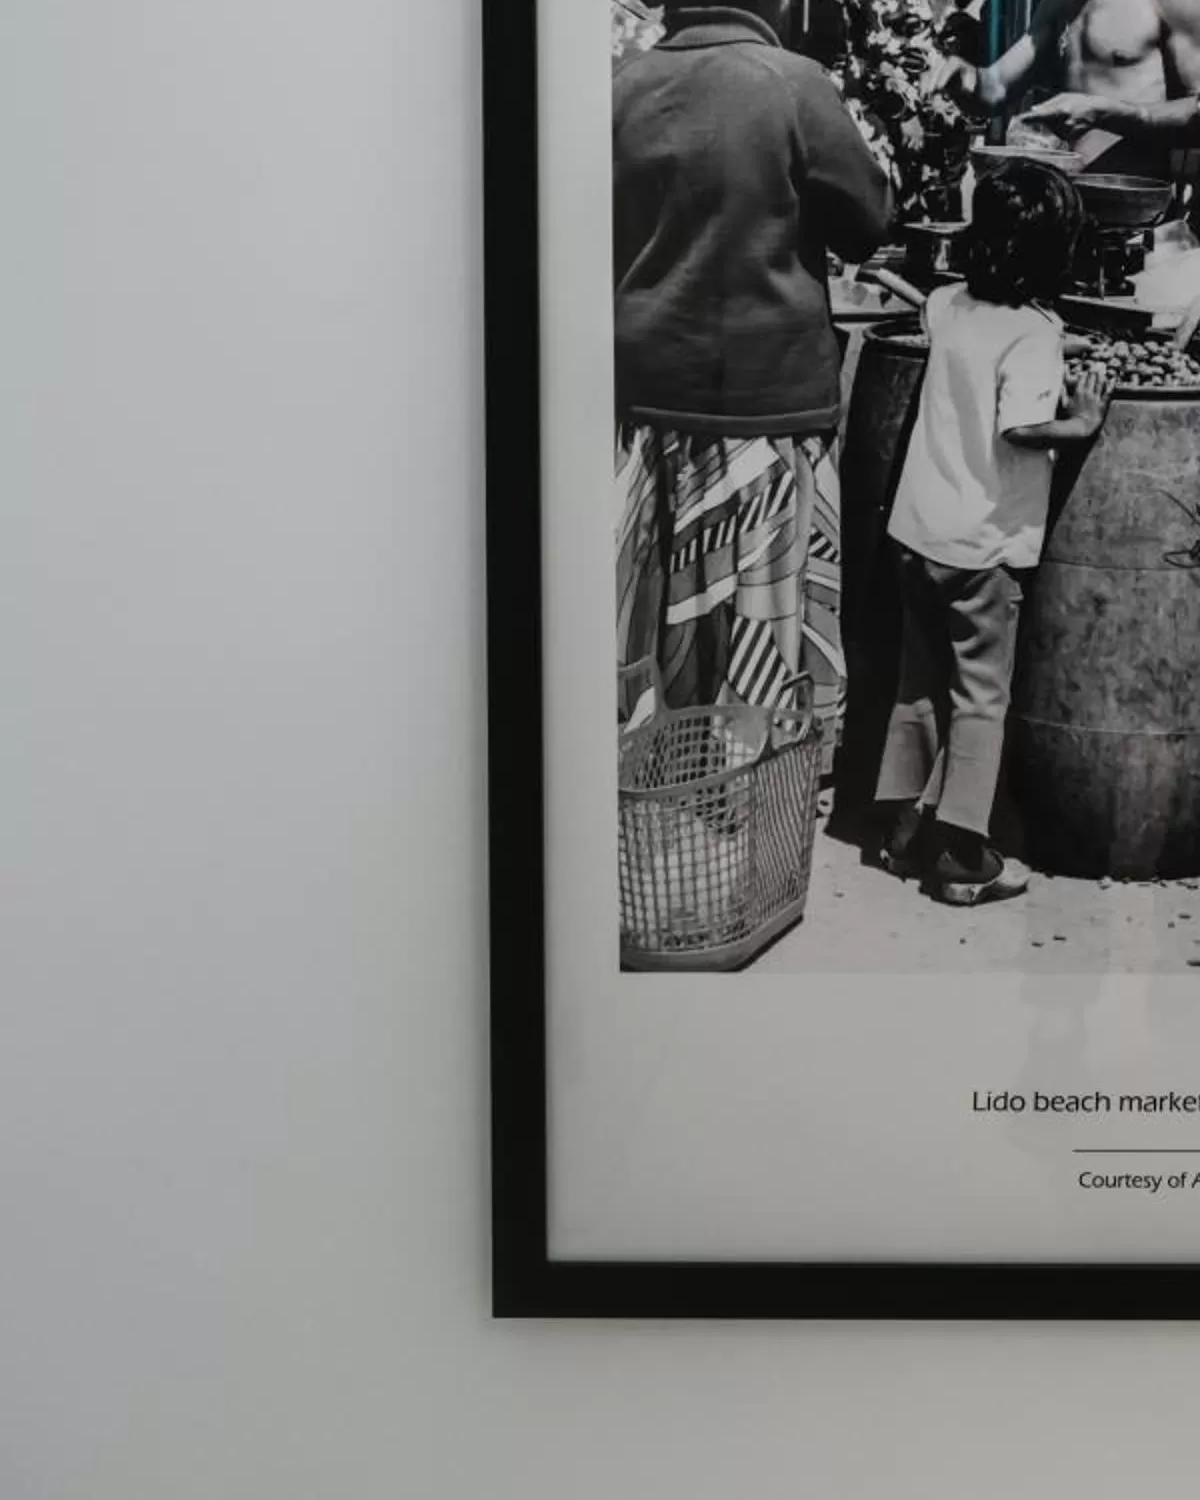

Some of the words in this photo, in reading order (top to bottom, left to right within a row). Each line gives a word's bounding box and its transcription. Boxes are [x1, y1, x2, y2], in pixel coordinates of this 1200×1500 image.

[972, 1091, 1026, 1114] Lido
[1032, 1091, 1112, 1114] beach
[1078, 1171, 1163, 1194] Courtesy
[1167, 1171, 1189, 1189] of
